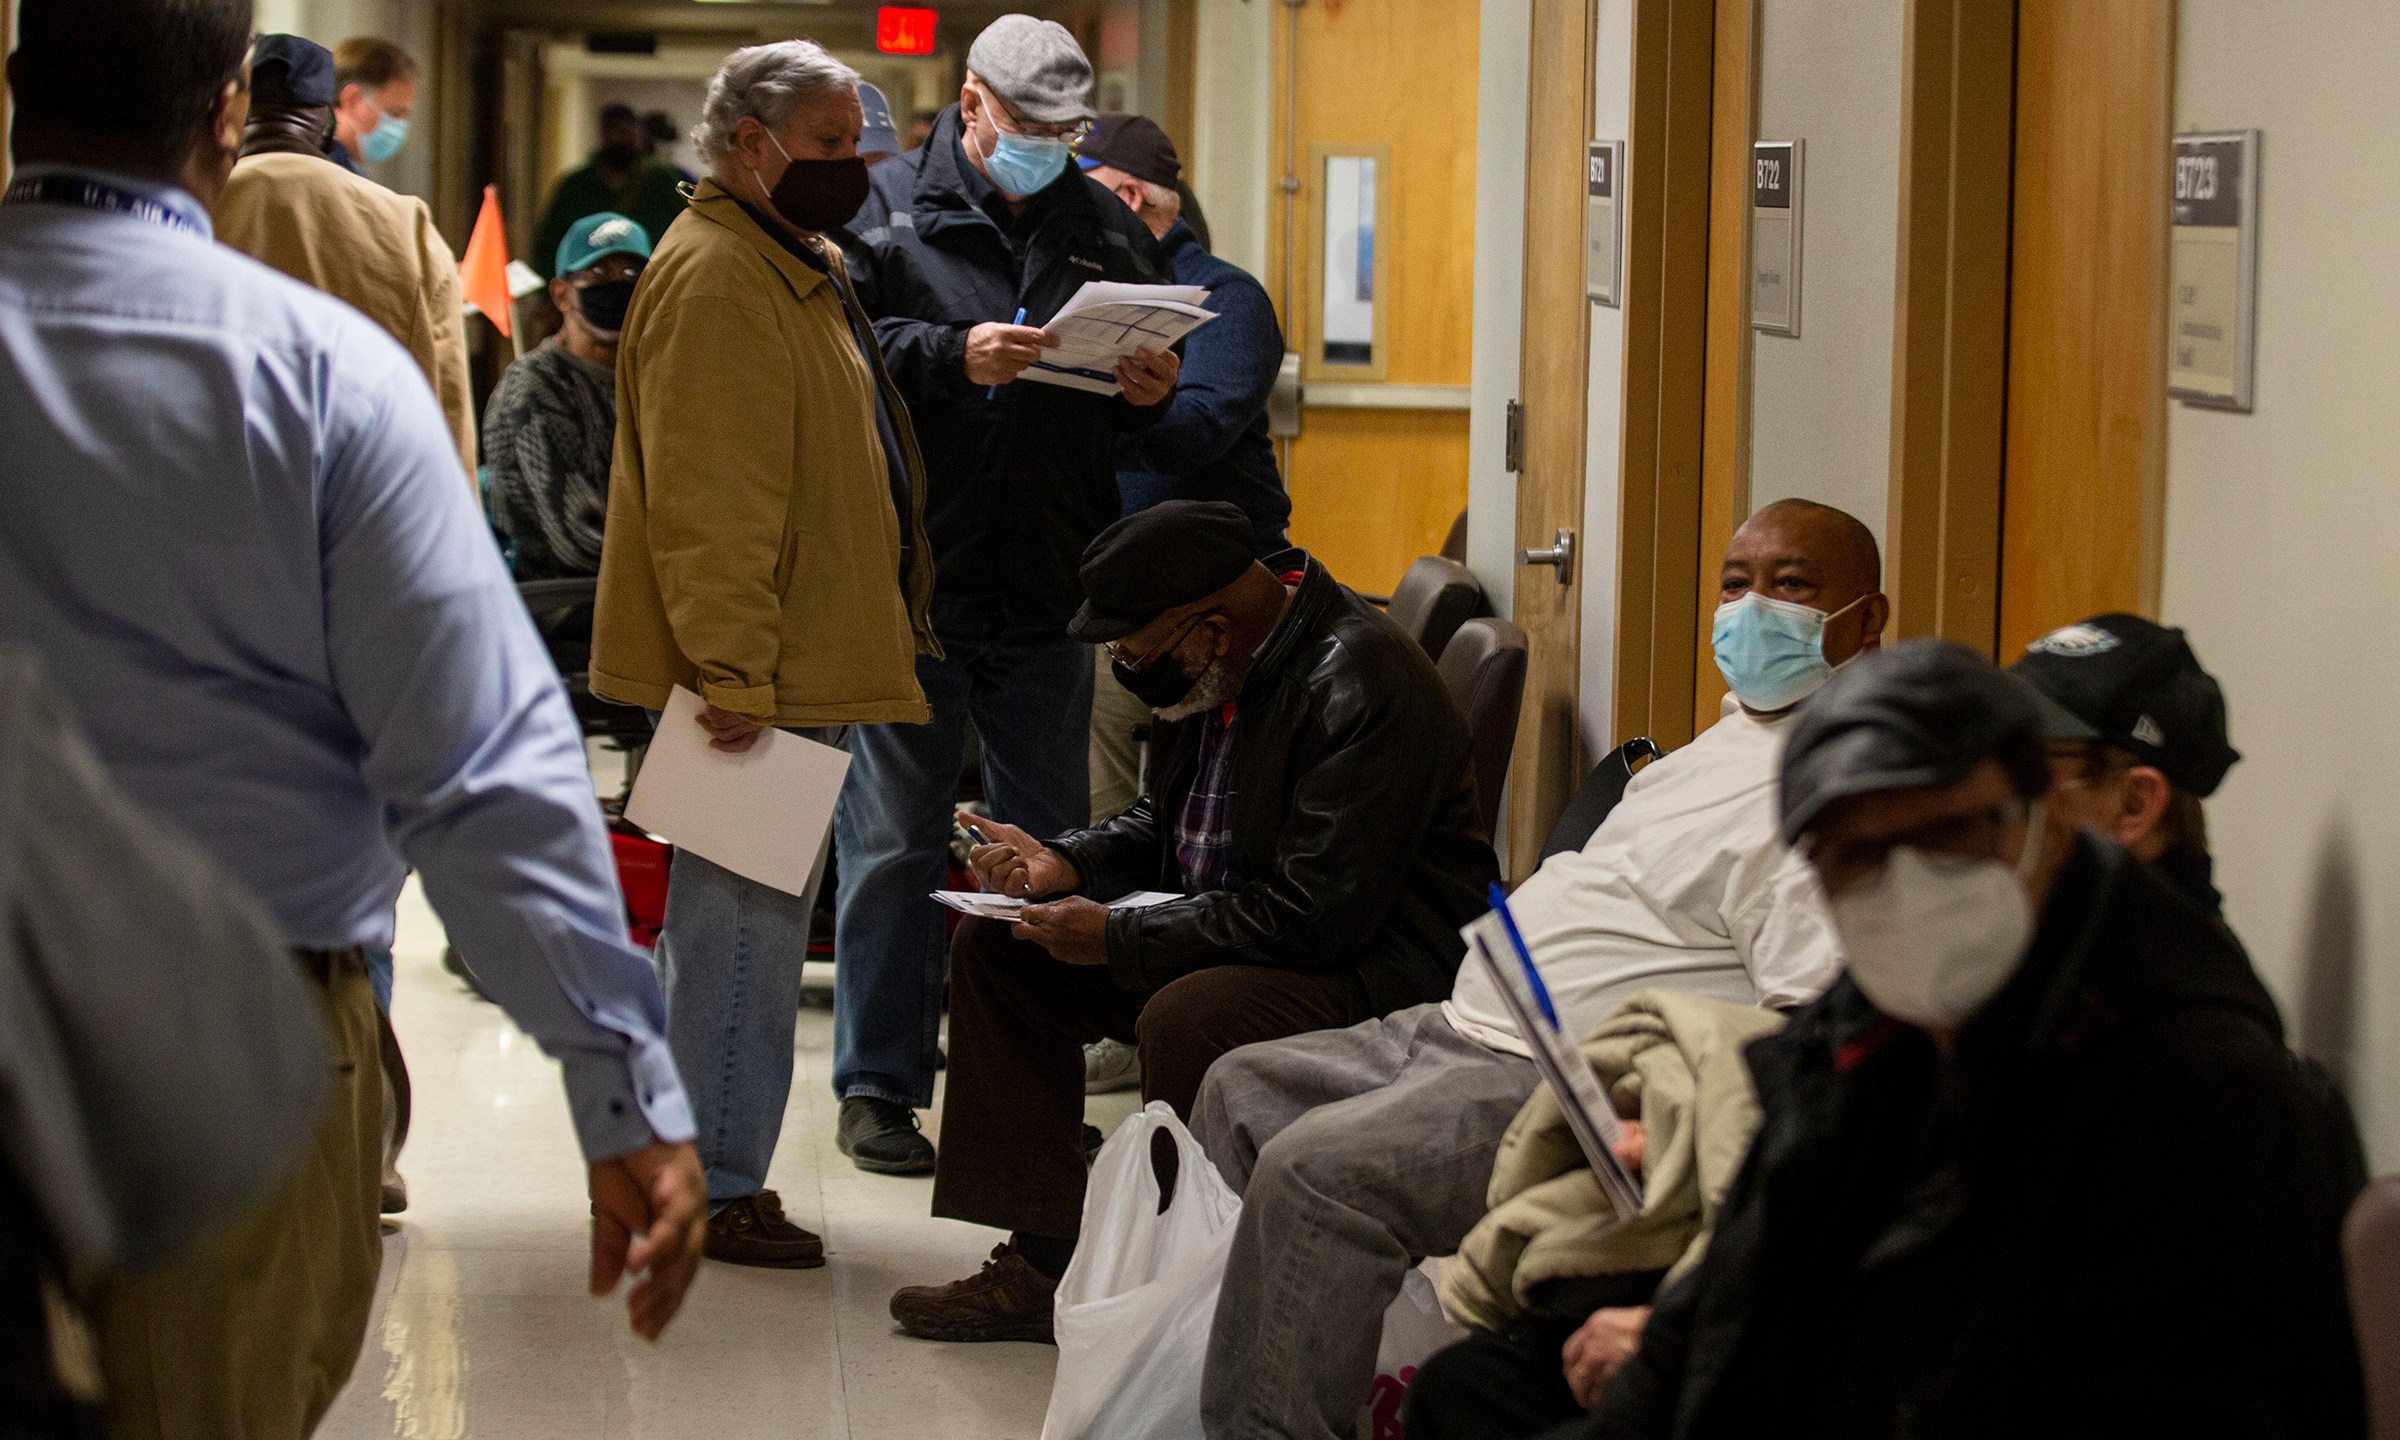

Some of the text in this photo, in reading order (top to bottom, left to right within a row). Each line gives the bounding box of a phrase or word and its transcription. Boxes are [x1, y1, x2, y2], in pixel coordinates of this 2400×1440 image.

[1757, 159, 1779, 189] B722
[2175, 156, 2218, 200] B723
[130, 199, 163, 226] AIR
